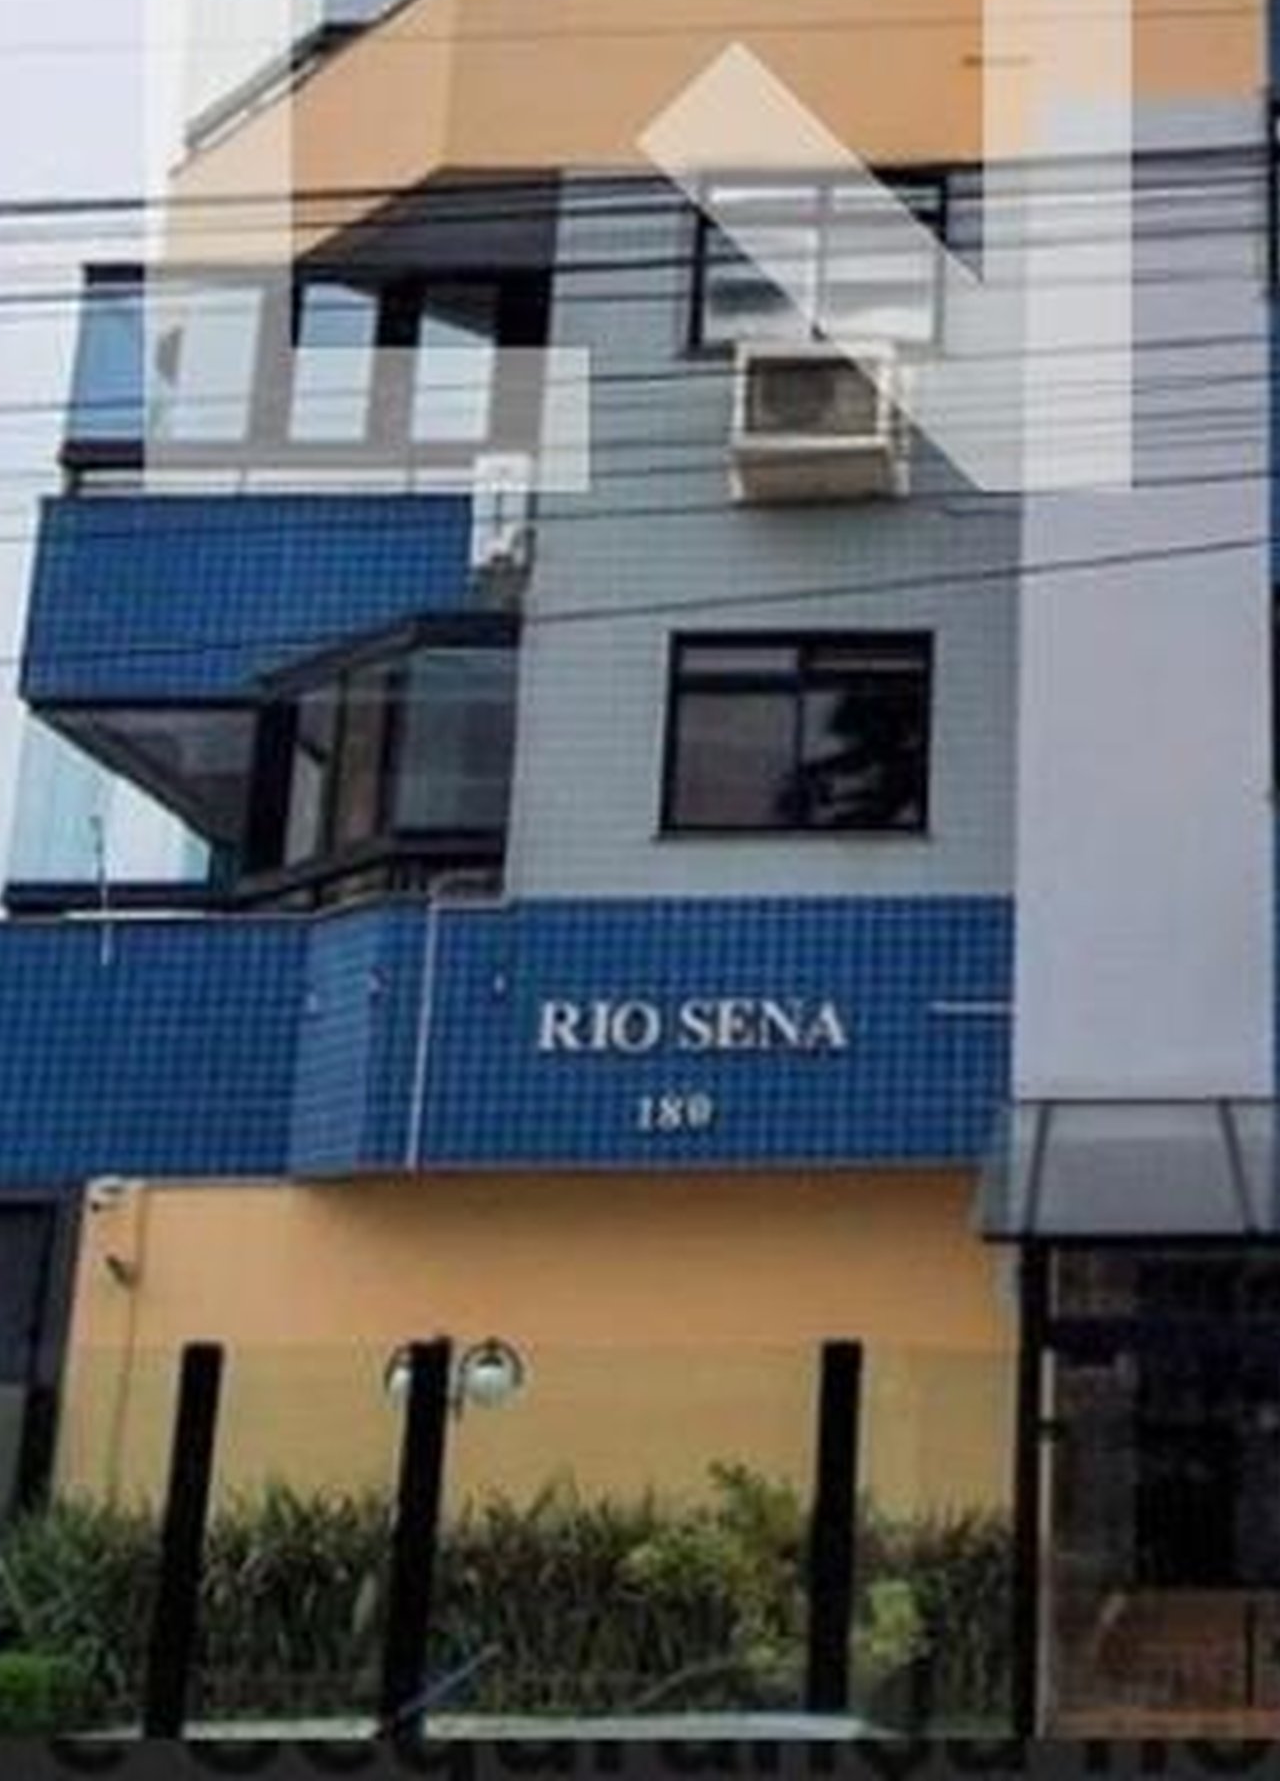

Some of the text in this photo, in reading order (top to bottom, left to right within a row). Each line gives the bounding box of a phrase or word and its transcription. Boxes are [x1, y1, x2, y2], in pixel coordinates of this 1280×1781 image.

[538, 999, 849, 1051] RIO SENA
[637, 1095, 712, 1131] 180
